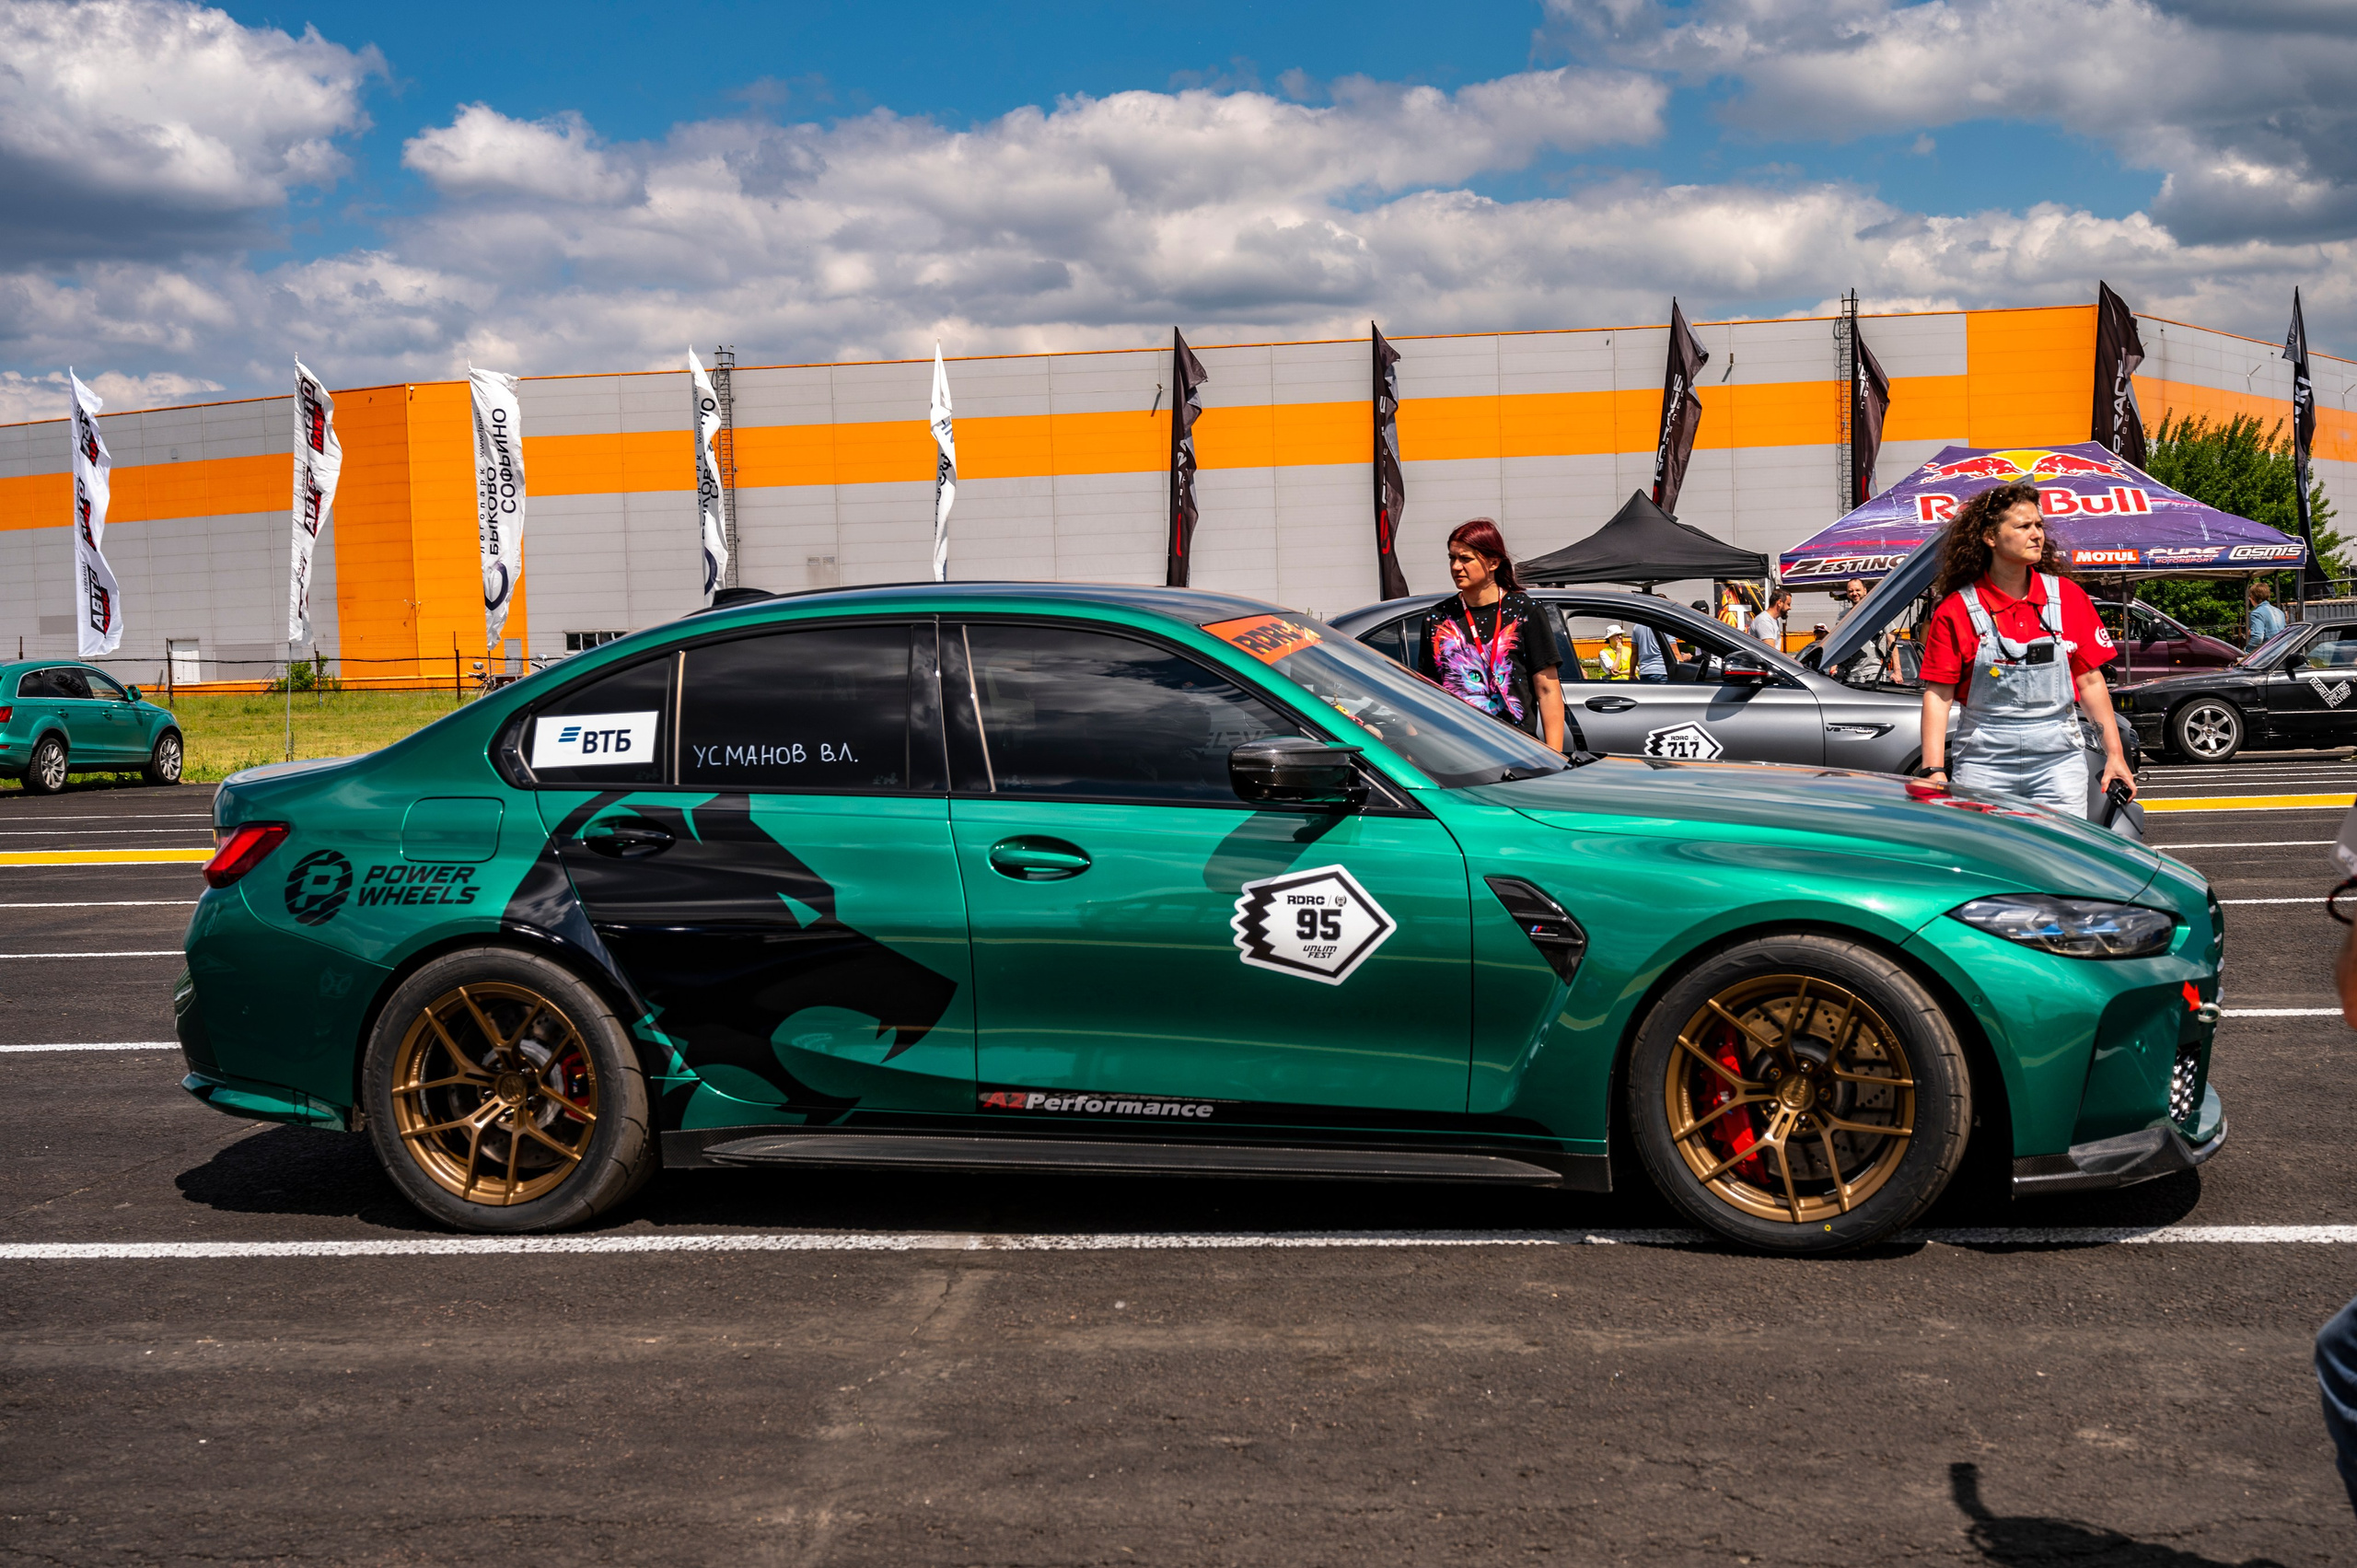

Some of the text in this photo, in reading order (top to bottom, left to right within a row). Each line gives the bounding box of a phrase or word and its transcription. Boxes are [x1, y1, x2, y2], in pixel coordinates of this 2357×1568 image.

[2112, 360, 2128, 454] ORACE
[492, 408, 517, 513] СОФЬИНО
[486, 466, 498, 555] БЫКОВО
[2039, 487, 2148, 517] Bull
[2075, 552, 2136, 563] MOTUL
[90, 571, 105, 633] АВТО
[582, 728, 632, 754] ВТБ
[1667, 741, 1699, 758] 717
[693, 743, 807, 768] УСМАНОВ
[364, 865, 476, 884] POWER
[357, 886, 481, 907] WHEELS
[1287, 895, 1325, 905] RDRC
[1296, 908, 1342, 941] 95
